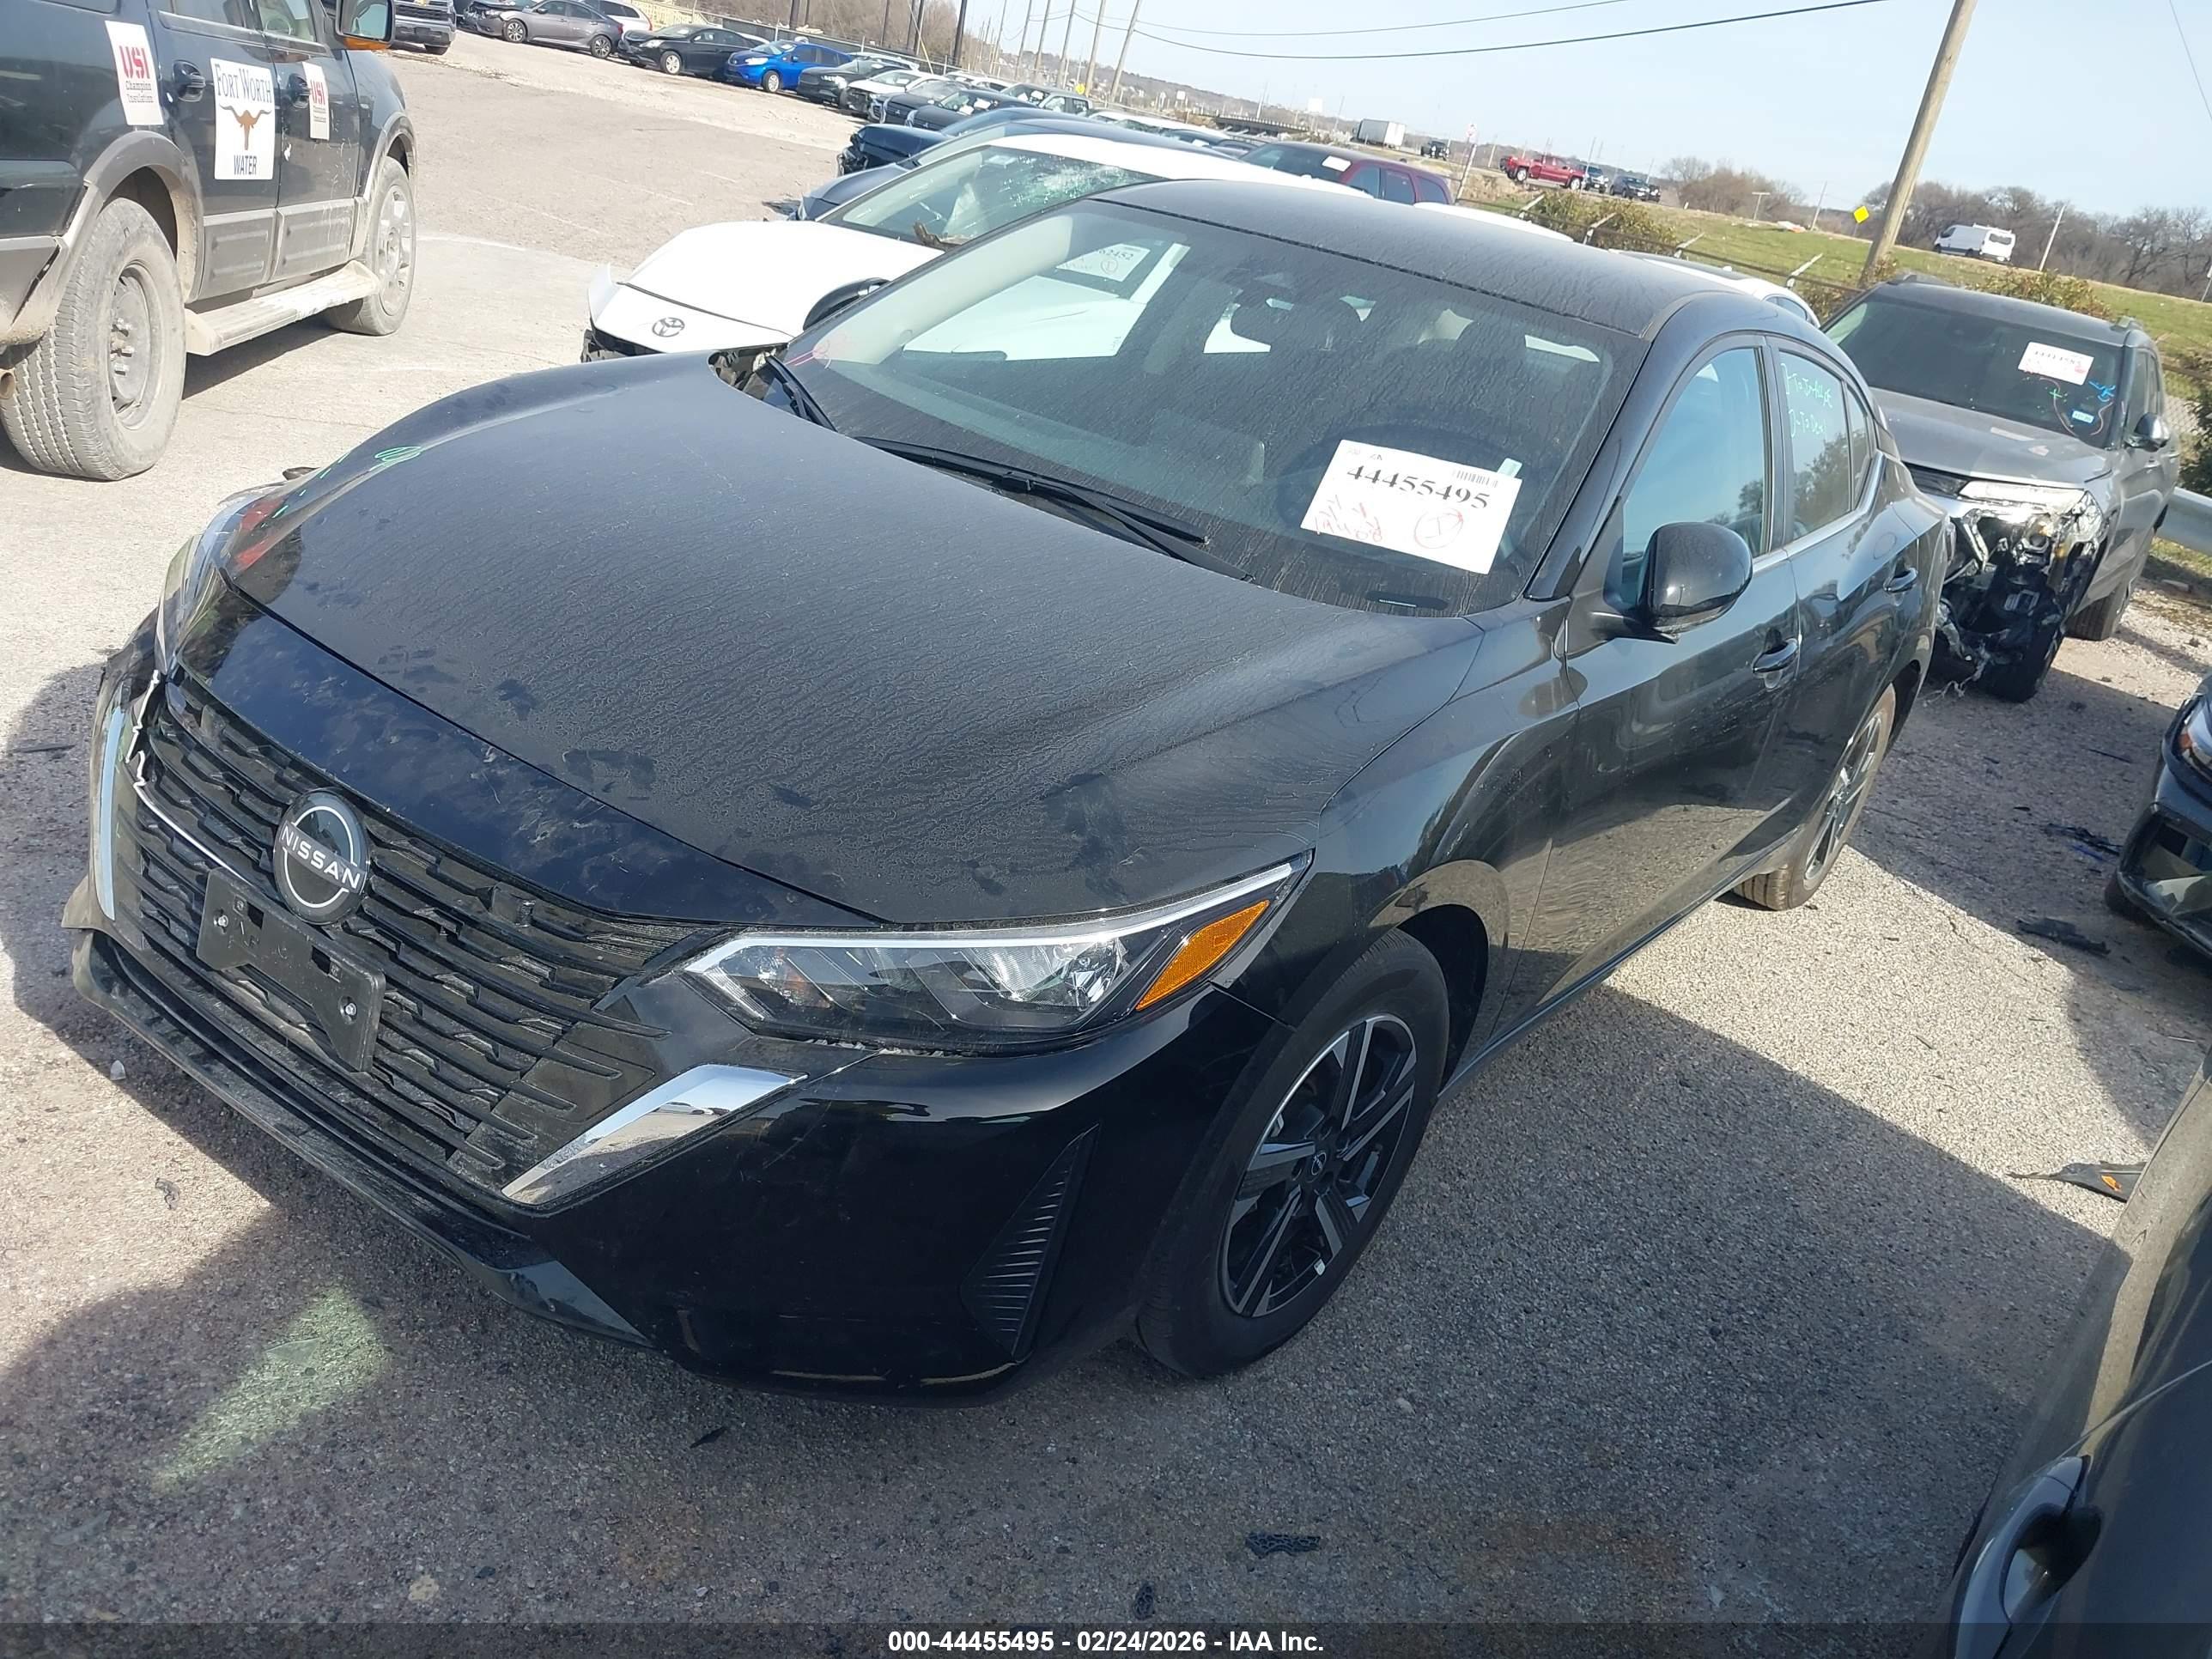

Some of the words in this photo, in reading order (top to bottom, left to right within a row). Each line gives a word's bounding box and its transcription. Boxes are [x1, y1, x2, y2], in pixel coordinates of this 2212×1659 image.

[119, 46, 150, 79] USI
[215, 64, 239, 99] FORT
[239, 68, 272, 104] WORTH
[310, 79, 325, 106] USI
[234, 155, 258, 175] WATER
[1346, 465, 1491, 509] 44455495
[281, 825, 361, 890] NISSAN
